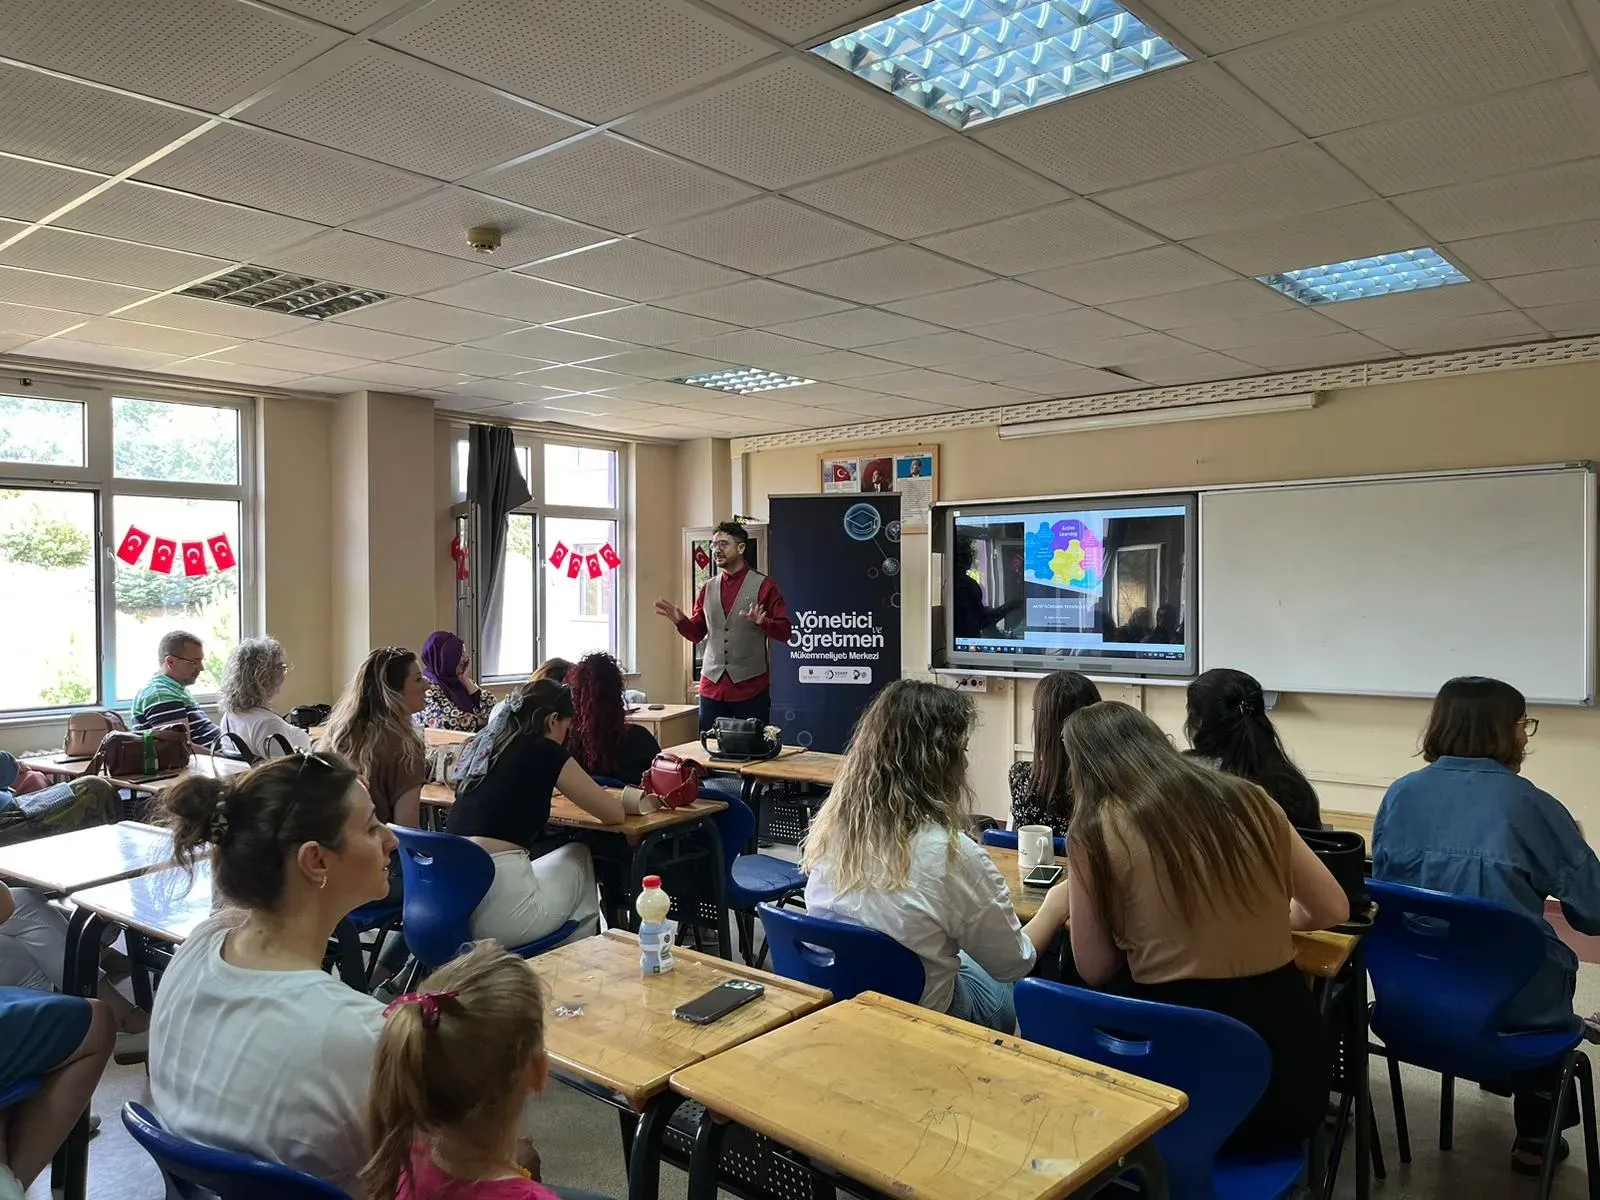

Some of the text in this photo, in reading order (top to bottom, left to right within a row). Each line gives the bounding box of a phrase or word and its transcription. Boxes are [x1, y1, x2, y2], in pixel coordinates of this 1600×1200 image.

[795, 611, 873, 629] Yönetici
[872, 626, 883, 634] ve
[787, 625, 884, 652] Öğretmen
[790, 651, 879, 661] Mükemmeliyet Merkezi
